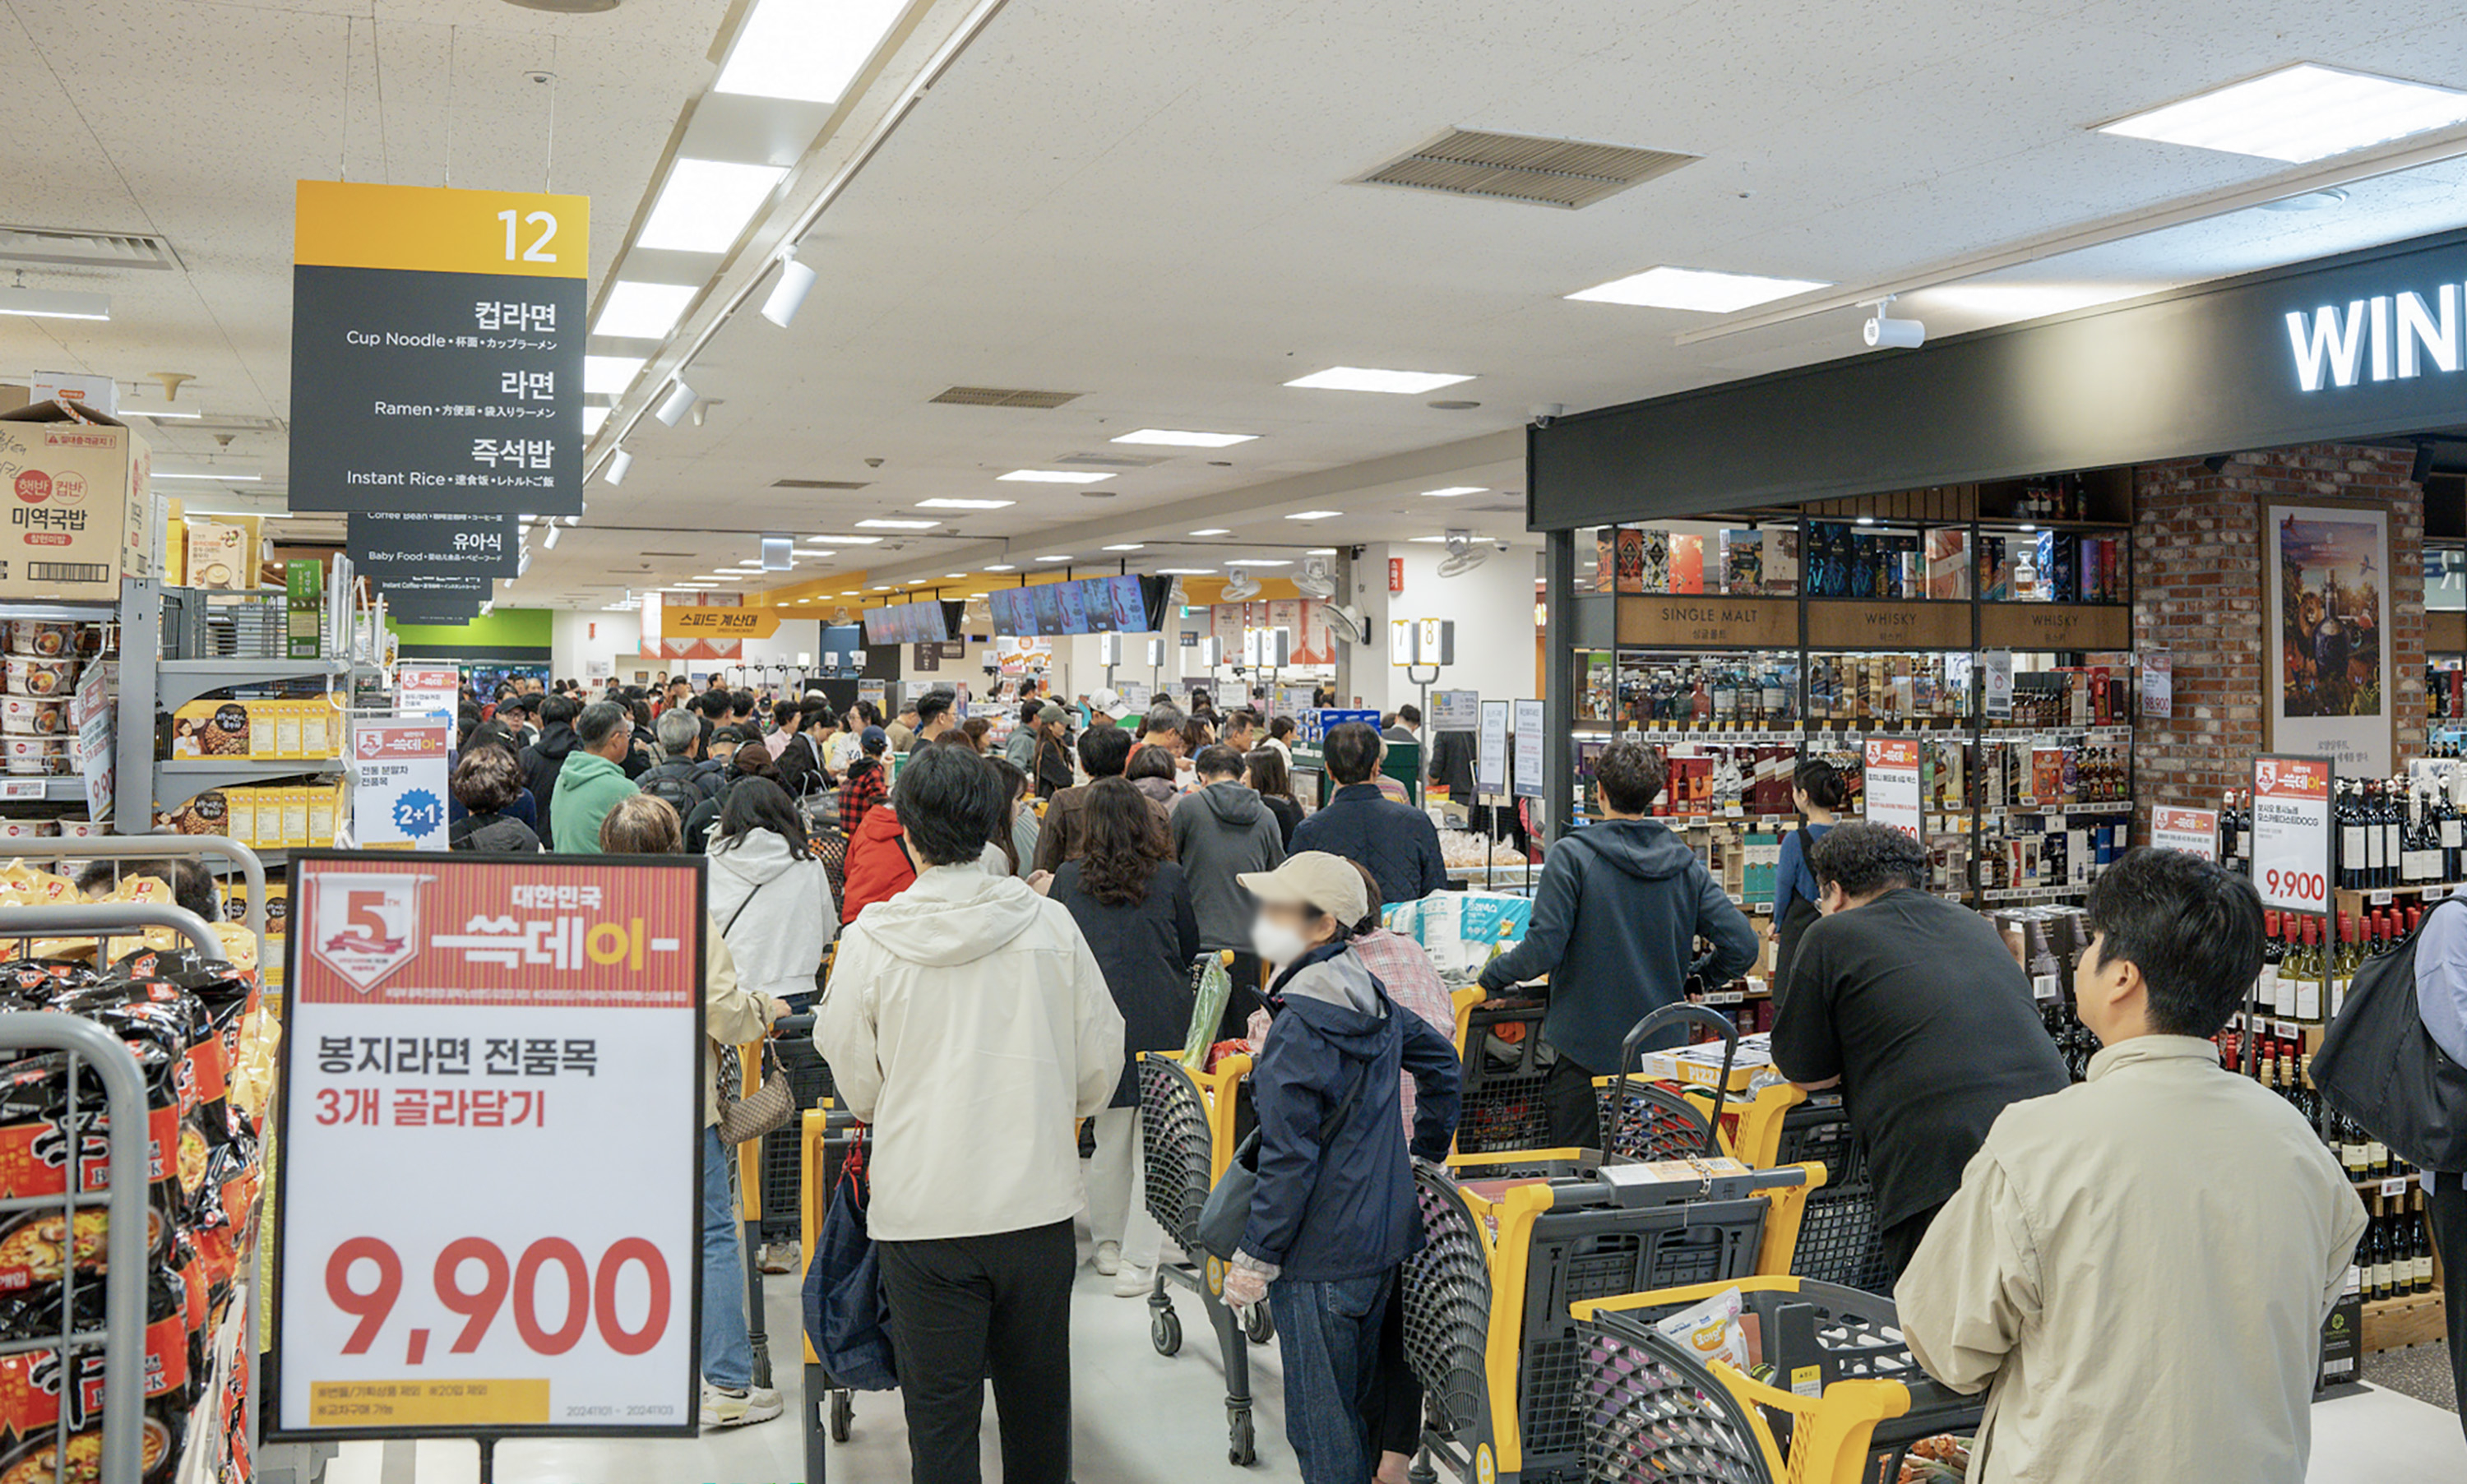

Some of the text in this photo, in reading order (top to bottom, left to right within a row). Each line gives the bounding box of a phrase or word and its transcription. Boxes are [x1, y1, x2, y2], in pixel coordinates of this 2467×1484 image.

[498, 209, 558, 262] 12
[474, 302, 556, 332] 컵라면
[346, 331, 381, 346] Cup
[386, 332, 446, 348] Noodle
[487, 338, 558, 350] カップラーメン
[2285, 280, 2467, 391] WIN
[502, 371, 554, 400] 라면
[375, 401, 432, 415] Ramen
[442, 405, 475, 417] 方便面
[471, 438, 555, 469] 즉석밥
[19, 478, 83, 497] 햇반 컵반
[347, 470, 405, 486] Instant
[410, 472, 445, 487] Rice
[497, 476, 554, 488] レトルトご飯
[12, 507, 88, 530] 미역국밥
[452, 533, 502, 552] 유아식
[368, 551, 395, 562] Baby
[397, 552, 423, 562] Food
[679, 613, 758, 626] 스피드 계산대
[1662, 608, 1757, 622] SINGLE MALT
[1865, 613, 1917, 626] WHISKY
[2031, 615, 2079, 626] WHISKY
[1425, 622, 1434, 645] 8
[1692, 629, 1727, 640] 싱글몰트
[2278, 773, 2320, 791] 쓱데이
[400, 803, 435, 825] 2+1
[2266, 868, 2326, 900] 9,900
[511, 885, 602, 910] 대한민국
[347, 890, 387, 954] 5
[431, 914, 645, 971] 쓱데이
[318, 1035, 598, 1076] 봉지라면 전품목
[316, 1088, 545, 1127] 3개 골라담기
[326, 1237, 671, 1365] 9,900
